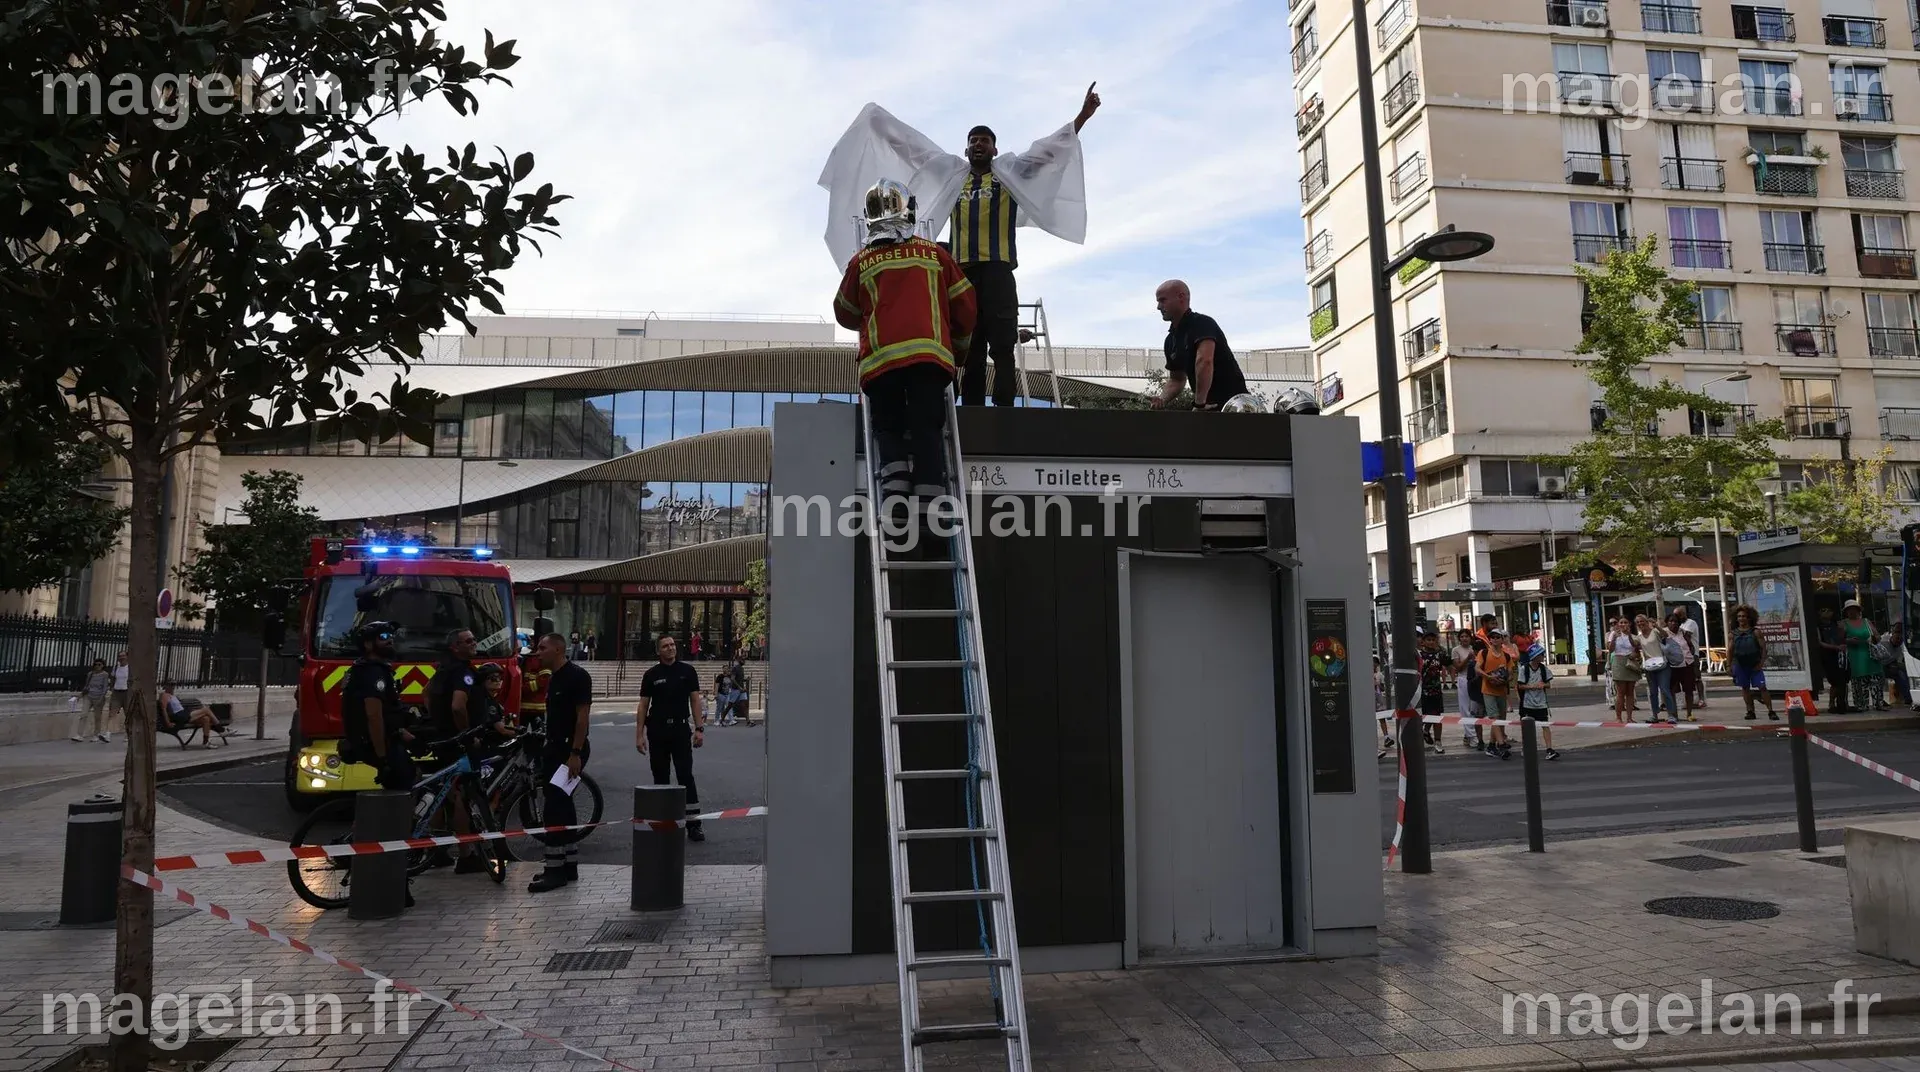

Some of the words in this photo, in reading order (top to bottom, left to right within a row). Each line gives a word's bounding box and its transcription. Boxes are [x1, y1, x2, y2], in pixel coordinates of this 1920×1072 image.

[859, 248, 938, 272] MARSEILLE
[1034, 468, 1122, 487] Toilettes
[638, 584, 680, 593] GALERIES
[683, 584, 732, 593] LAFAYETTE
